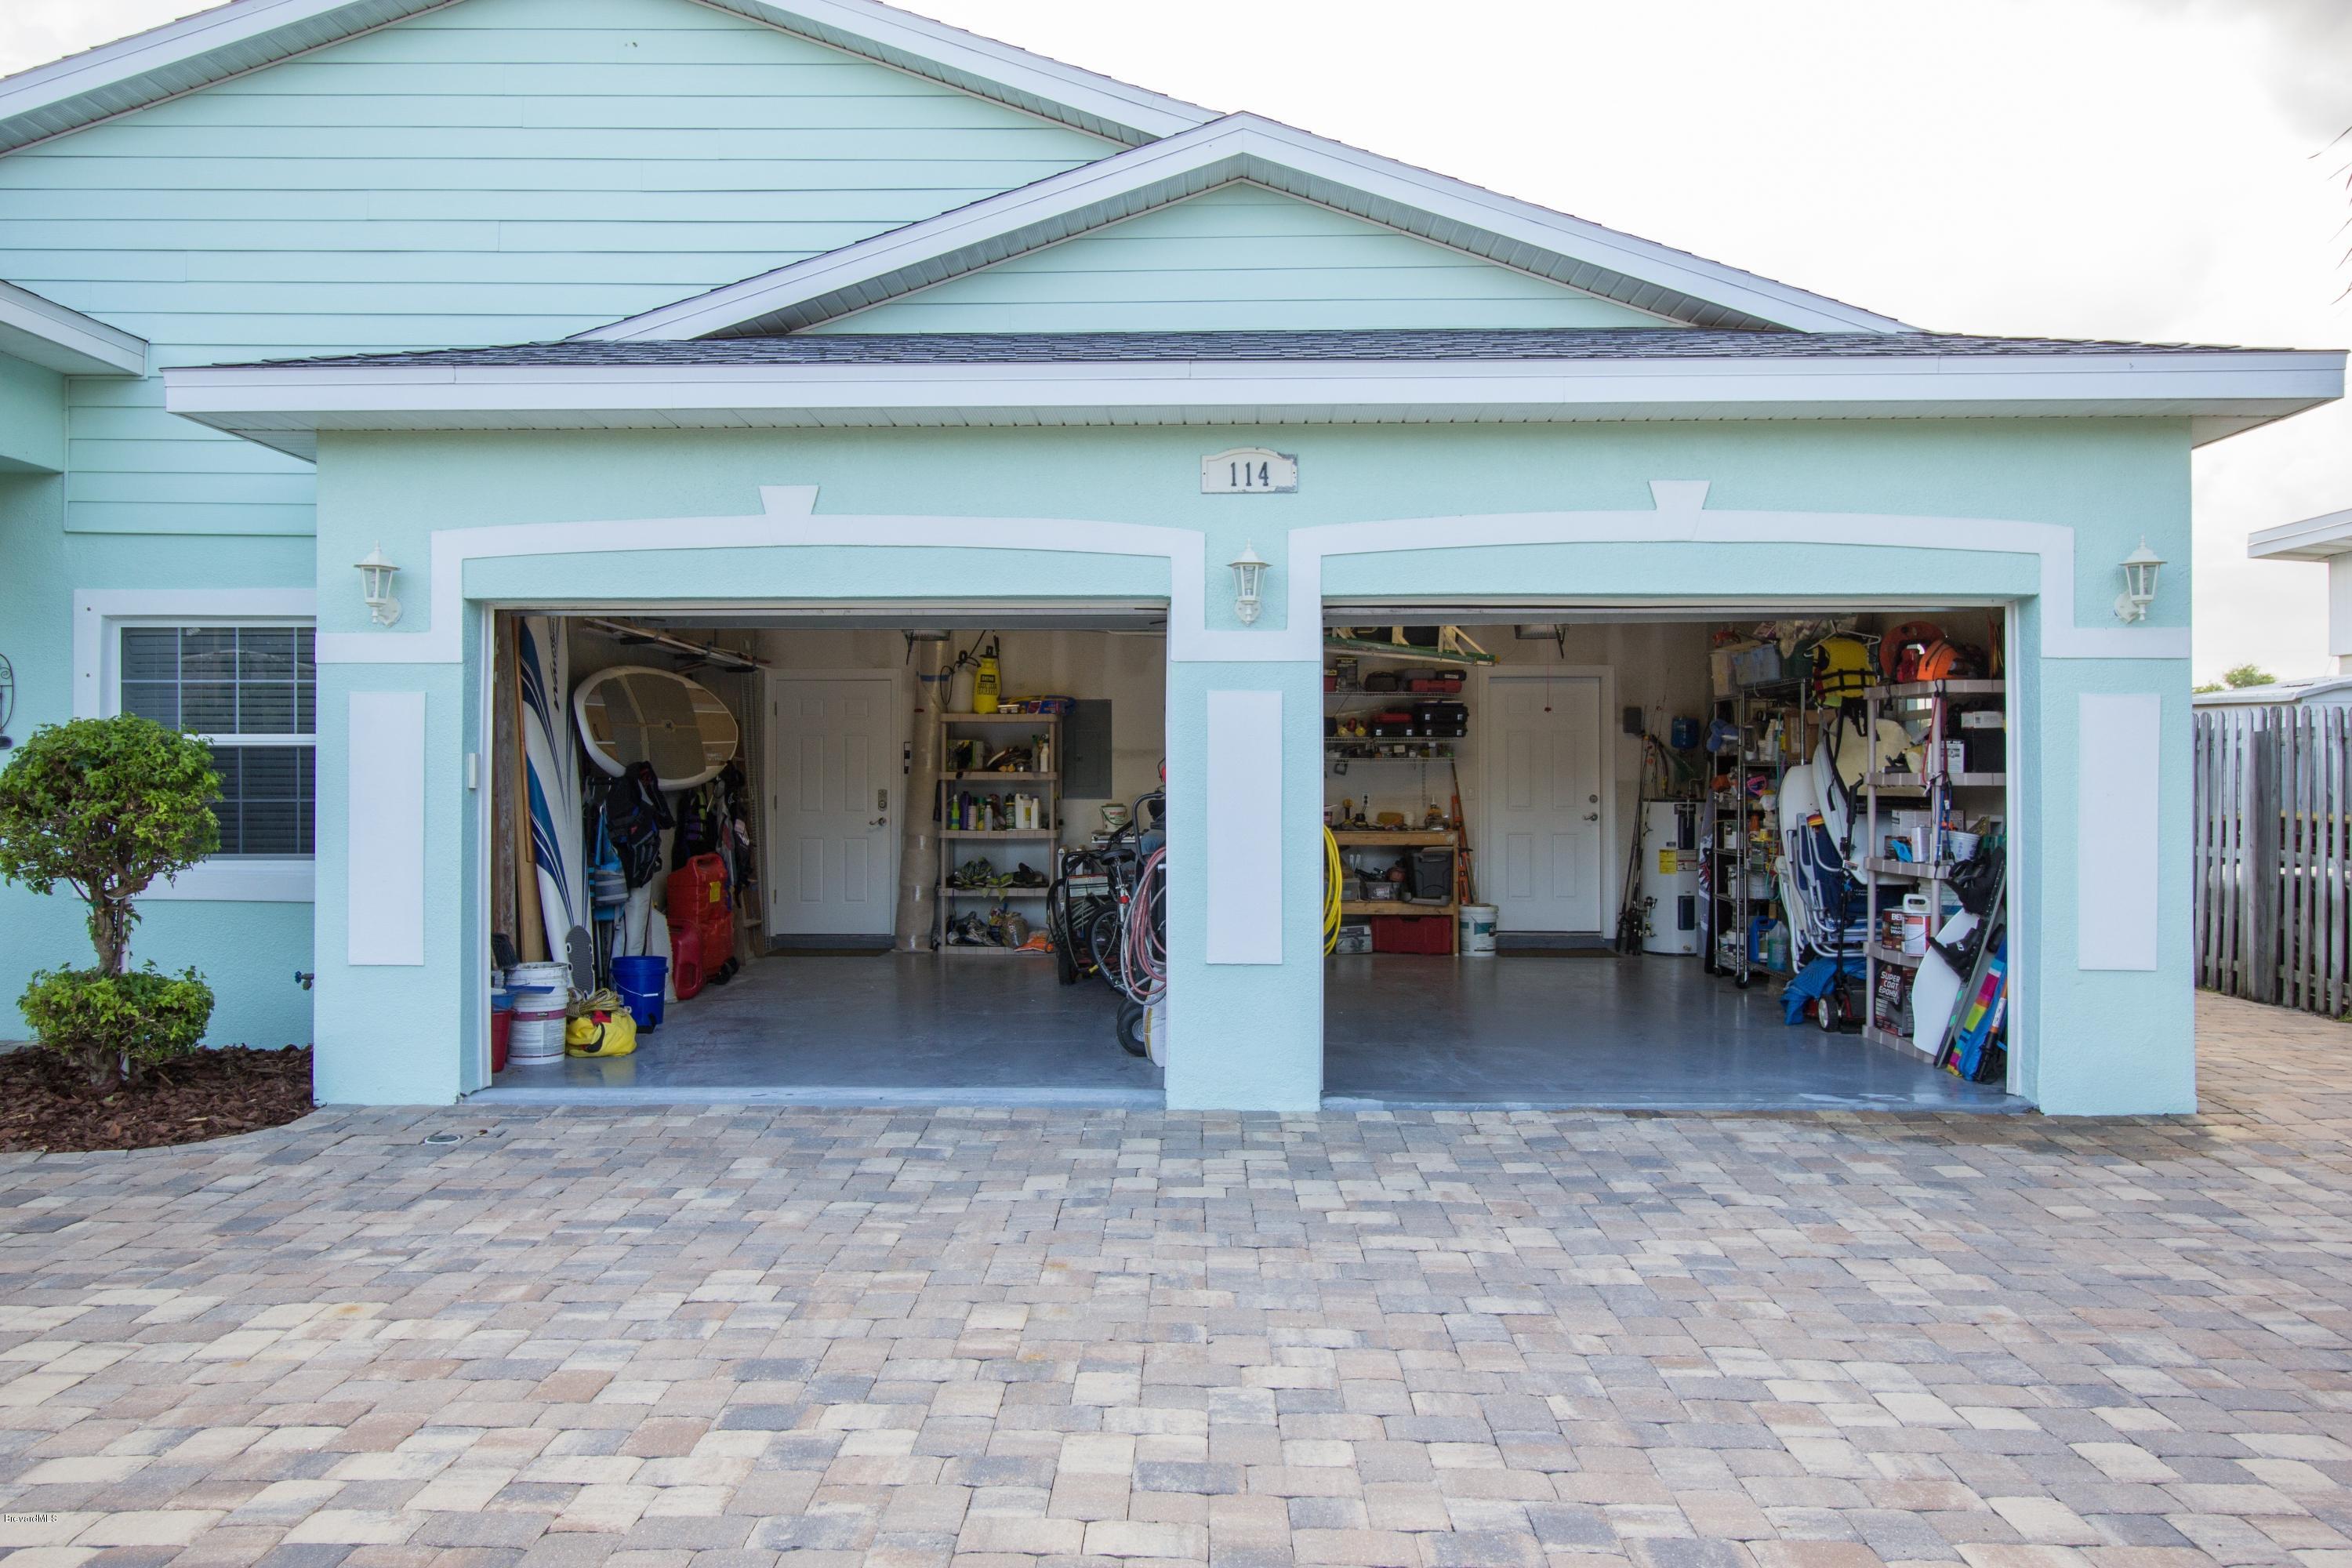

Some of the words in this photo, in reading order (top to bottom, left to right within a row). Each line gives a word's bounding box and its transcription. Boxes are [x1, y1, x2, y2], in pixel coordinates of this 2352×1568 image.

[1230, 461, 1269, 486] 114
[1881, 971, 1900, 982] SUPER
[1883, 980, 1899, 990] COAT
[1878, 985, 1897, 997] EPOXY
